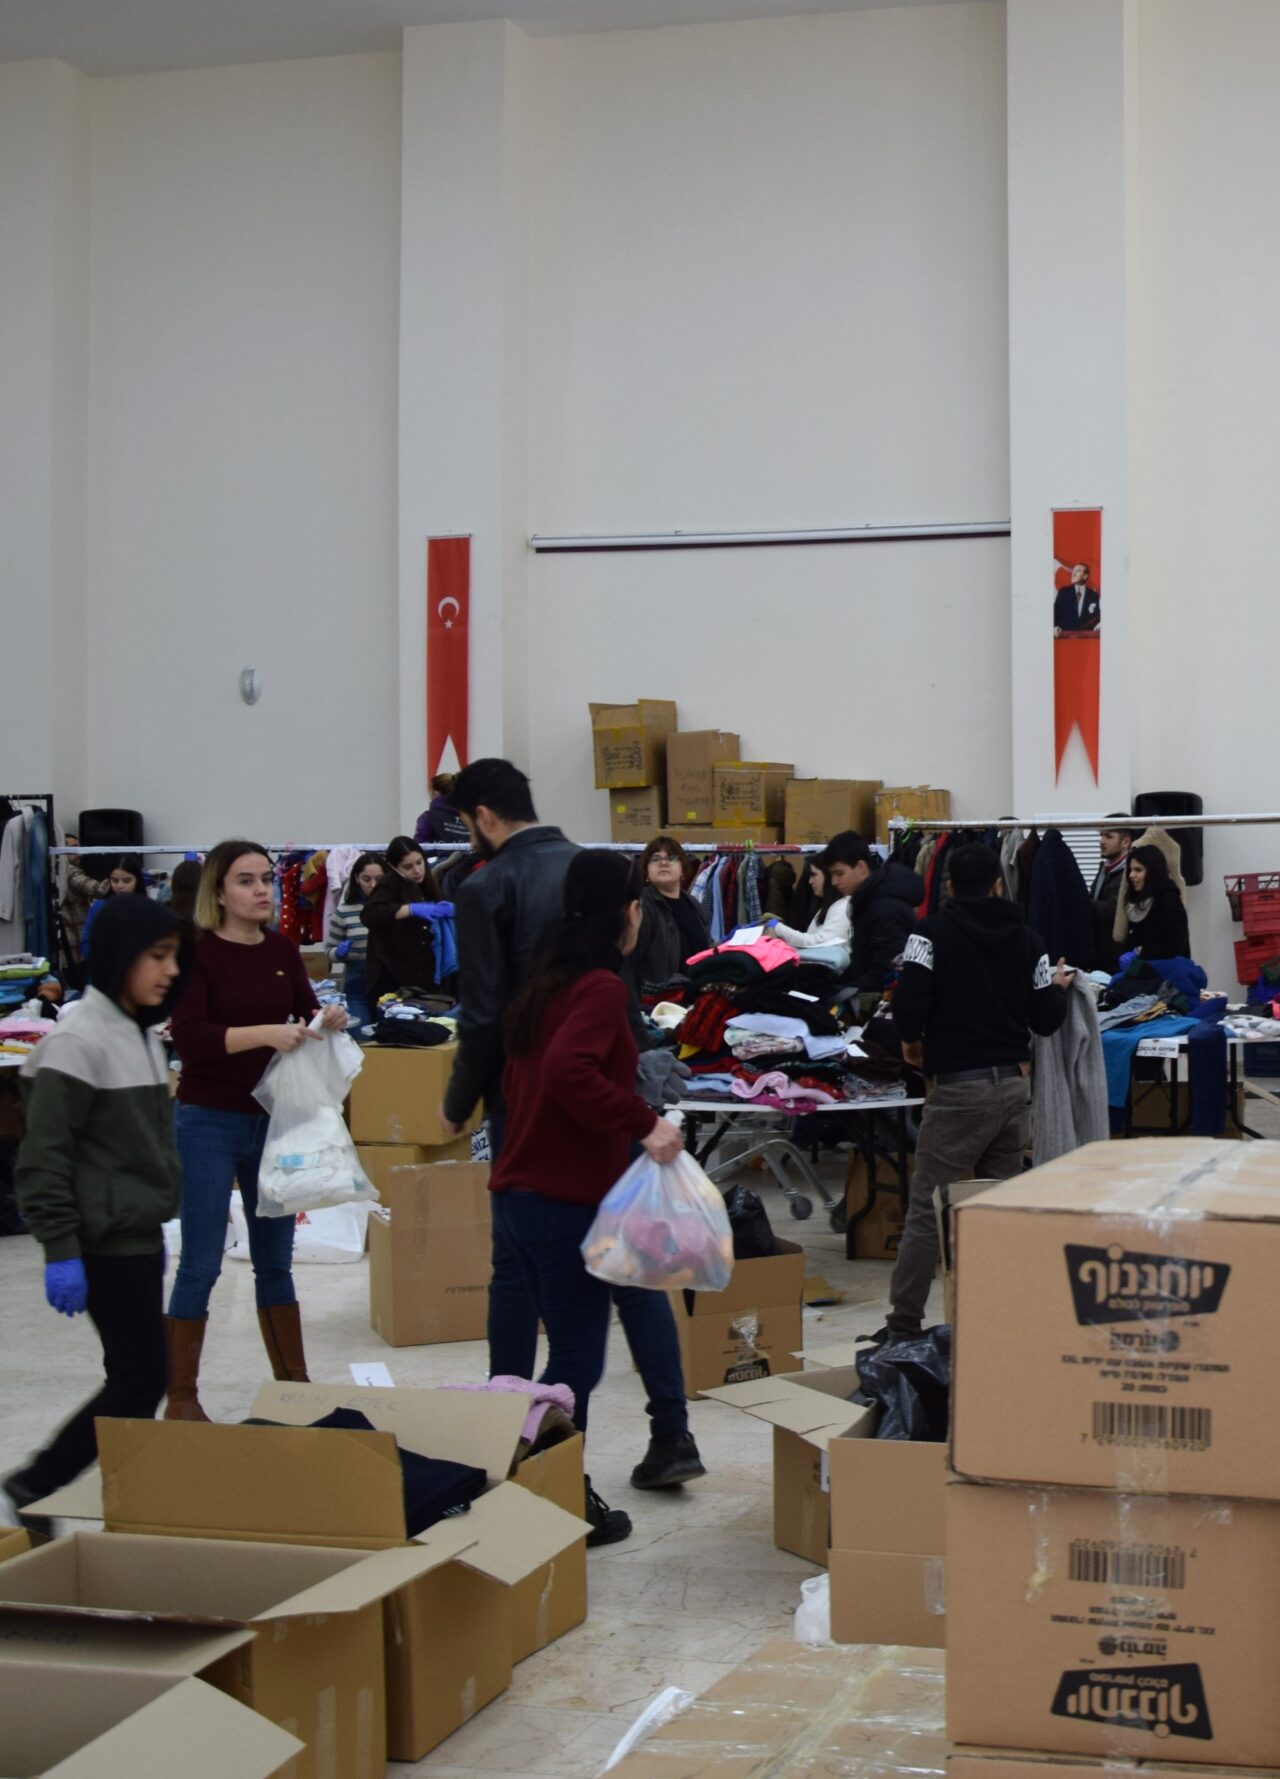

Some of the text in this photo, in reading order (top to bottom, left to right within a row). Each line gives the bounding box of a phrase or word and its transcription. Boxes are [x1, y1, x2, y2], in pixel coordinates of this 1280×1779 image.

[1078, 1250, 1215, 1305] יוחננוף
[1118, 1640, 1168, 1658] נורמה
[1065, 1683, 1199, 1734] יוחננוף
